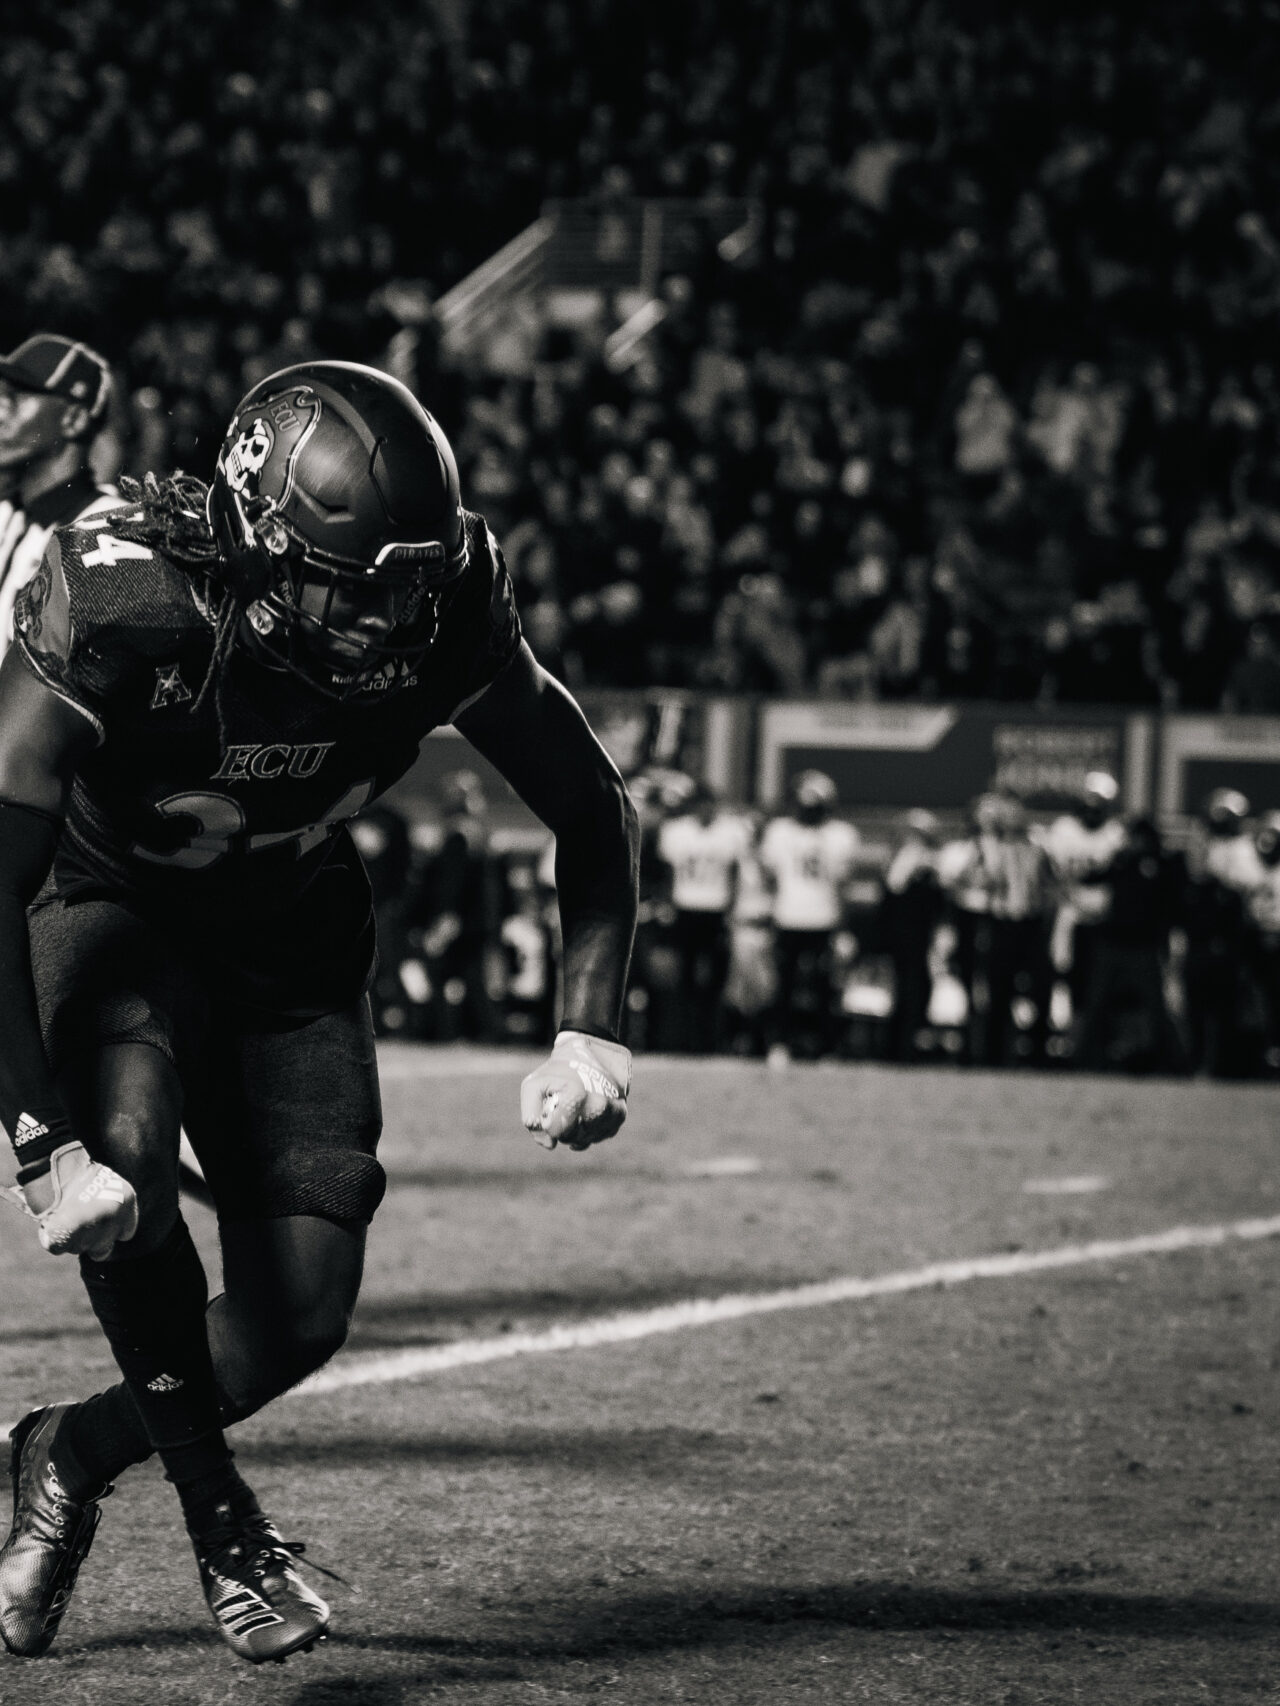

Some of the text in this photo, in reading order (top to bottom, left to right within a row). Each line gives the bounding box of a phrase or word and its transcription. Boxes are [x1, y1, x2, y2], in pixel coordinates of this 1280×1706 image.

[270, 400, 300, 431] ECU
[394, 547, 440, 559] PIRATES
[210, 741, 336, 780] ECU
[128, 776, 376, 870] 34
[14, 1124, 49, 1147] adidas
[147, 1379, 184, 1391] adidas
